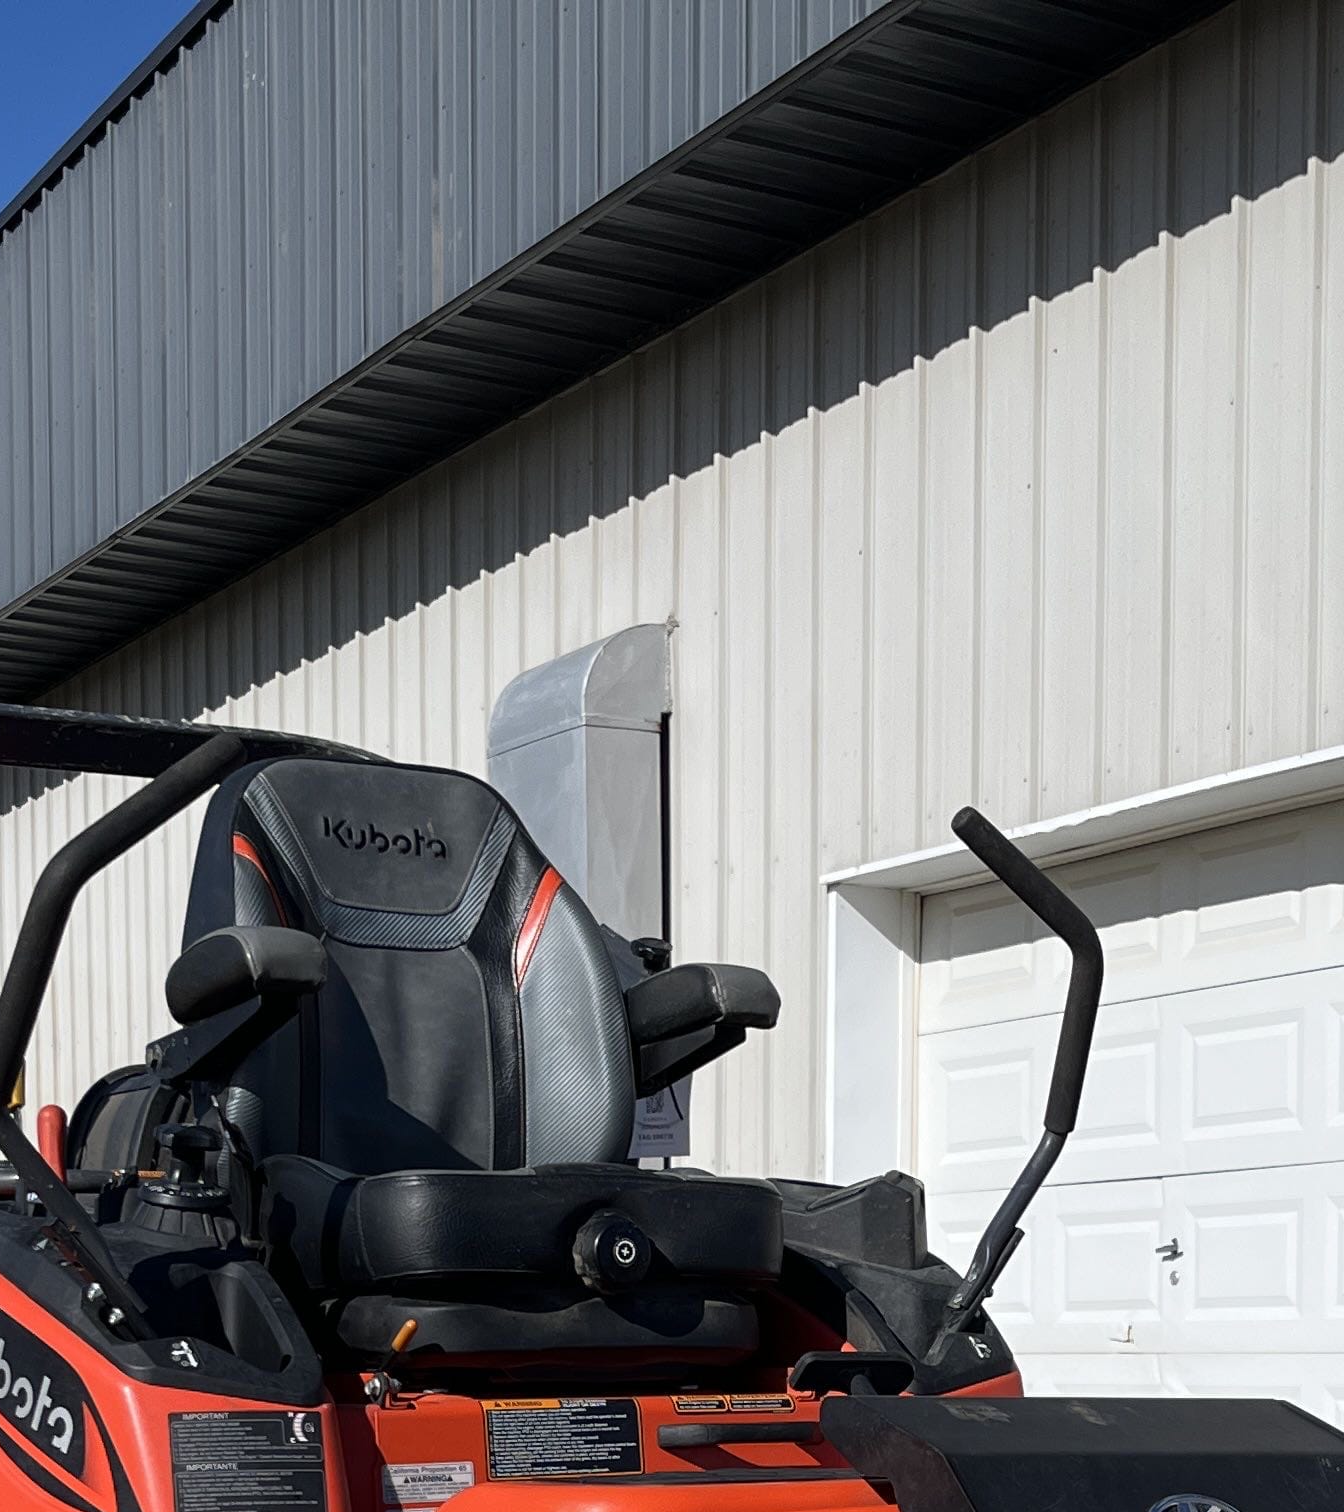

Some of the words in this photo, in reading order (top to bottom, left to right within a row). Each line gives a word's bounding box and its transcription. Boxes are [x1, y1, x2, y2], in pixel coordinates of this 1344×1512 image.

[322, 815, 446, 859] Kubota
[182, 1412, 230, 1421] IMPORTANT
[186, 1463, 238, 1471] IMPORTANTE
[410, 1474, 448, 1483] WARNING
